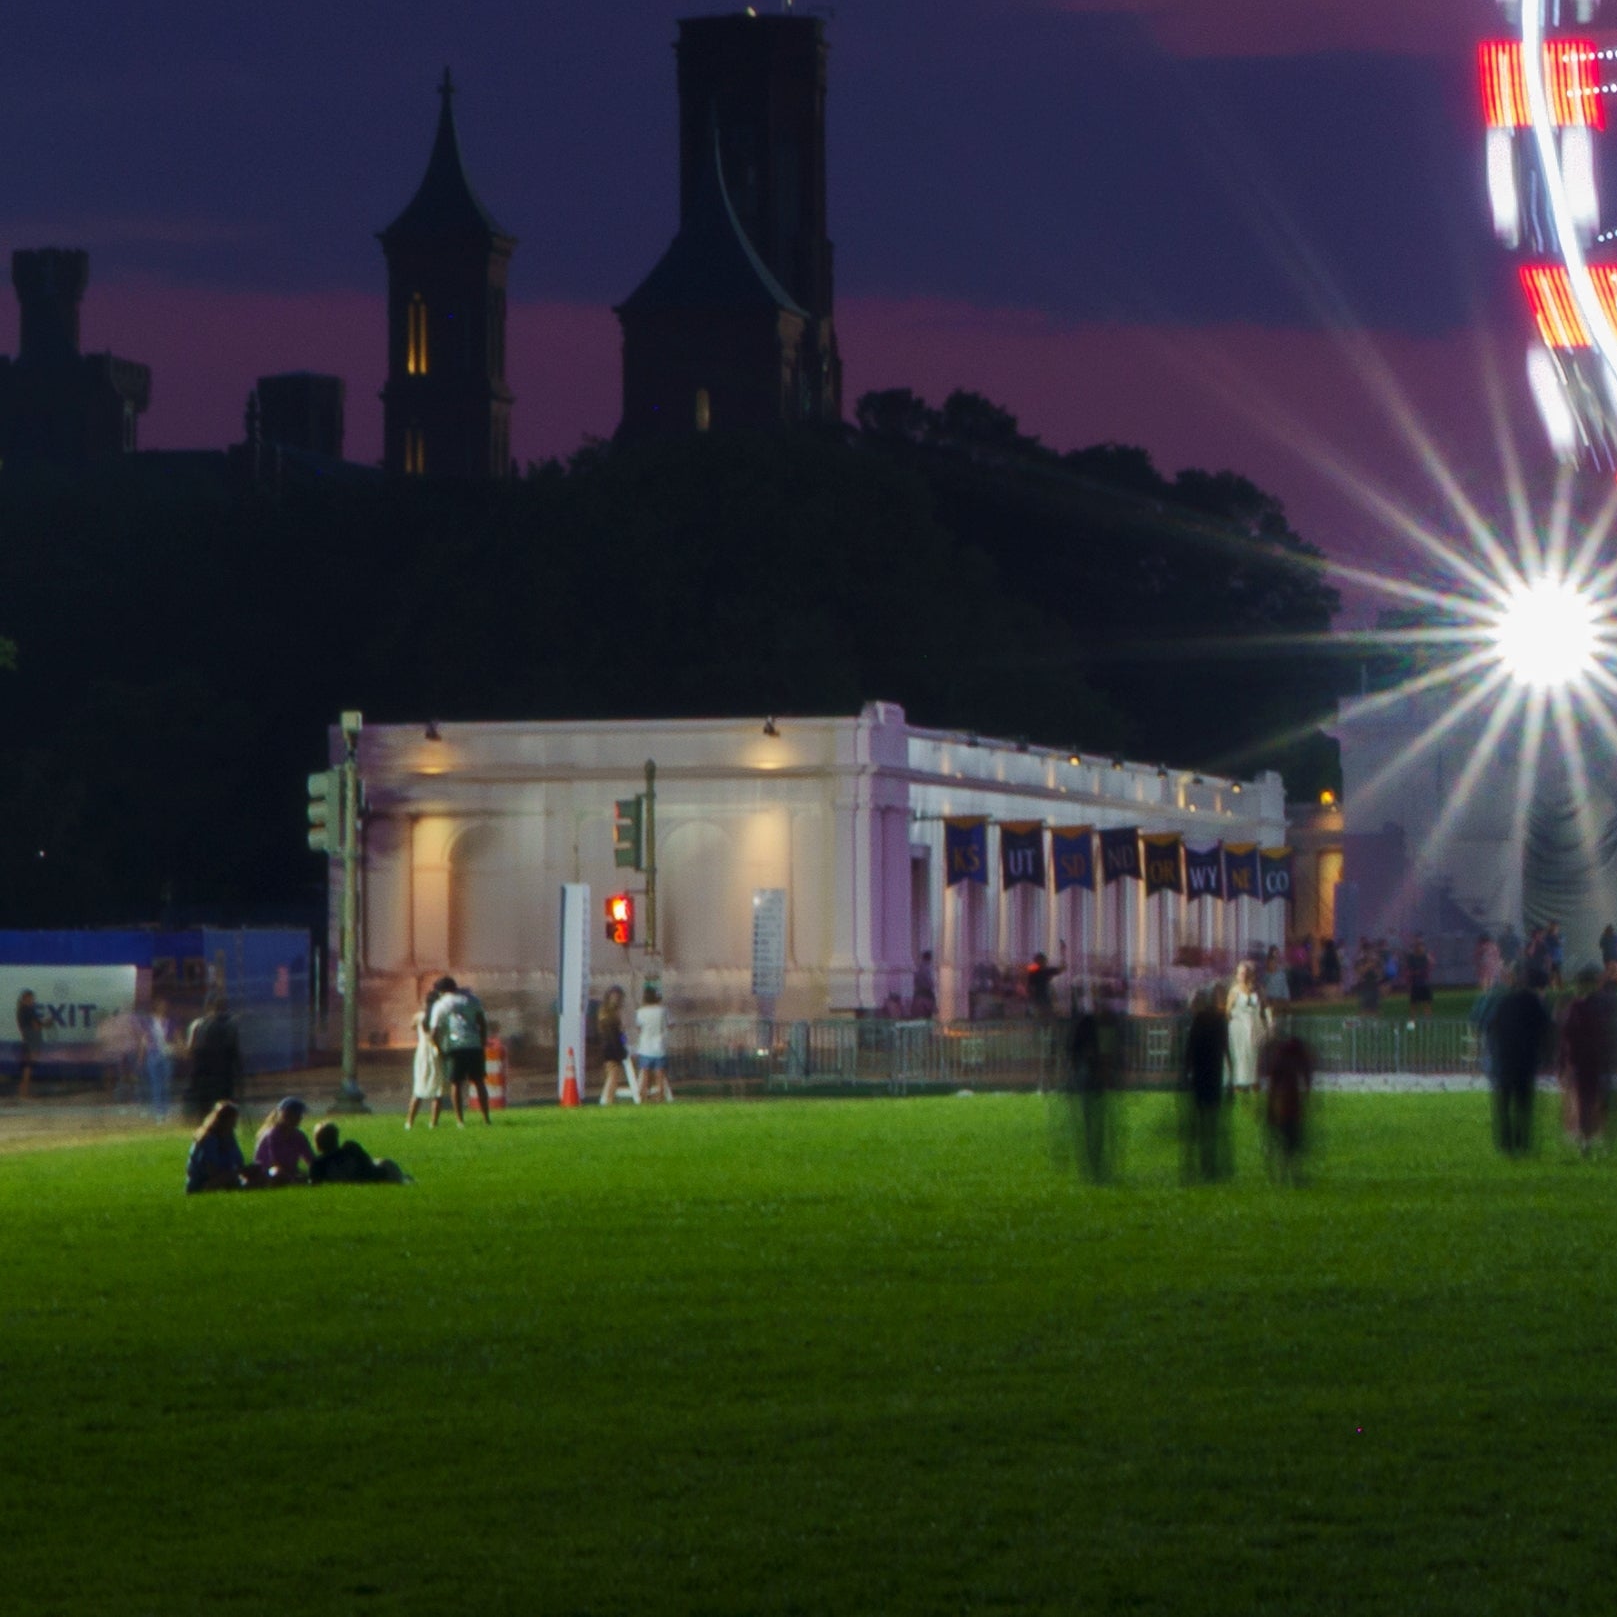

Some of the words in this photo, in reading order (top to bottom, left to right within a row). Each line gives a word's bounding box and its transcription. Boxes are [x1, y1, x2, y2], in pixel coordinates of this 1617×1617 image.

[954, 844, 981, 872] KS
[1009, 848, 1035, 876] UT
[1060, 853, 1086, 879] SD
[1107, 844, 1135, 871] ND
[1190, 866, 1218, 890] WY
[1266, 871, 1289, 893] CO
[34, 1003, 97, 1028] EXIT
